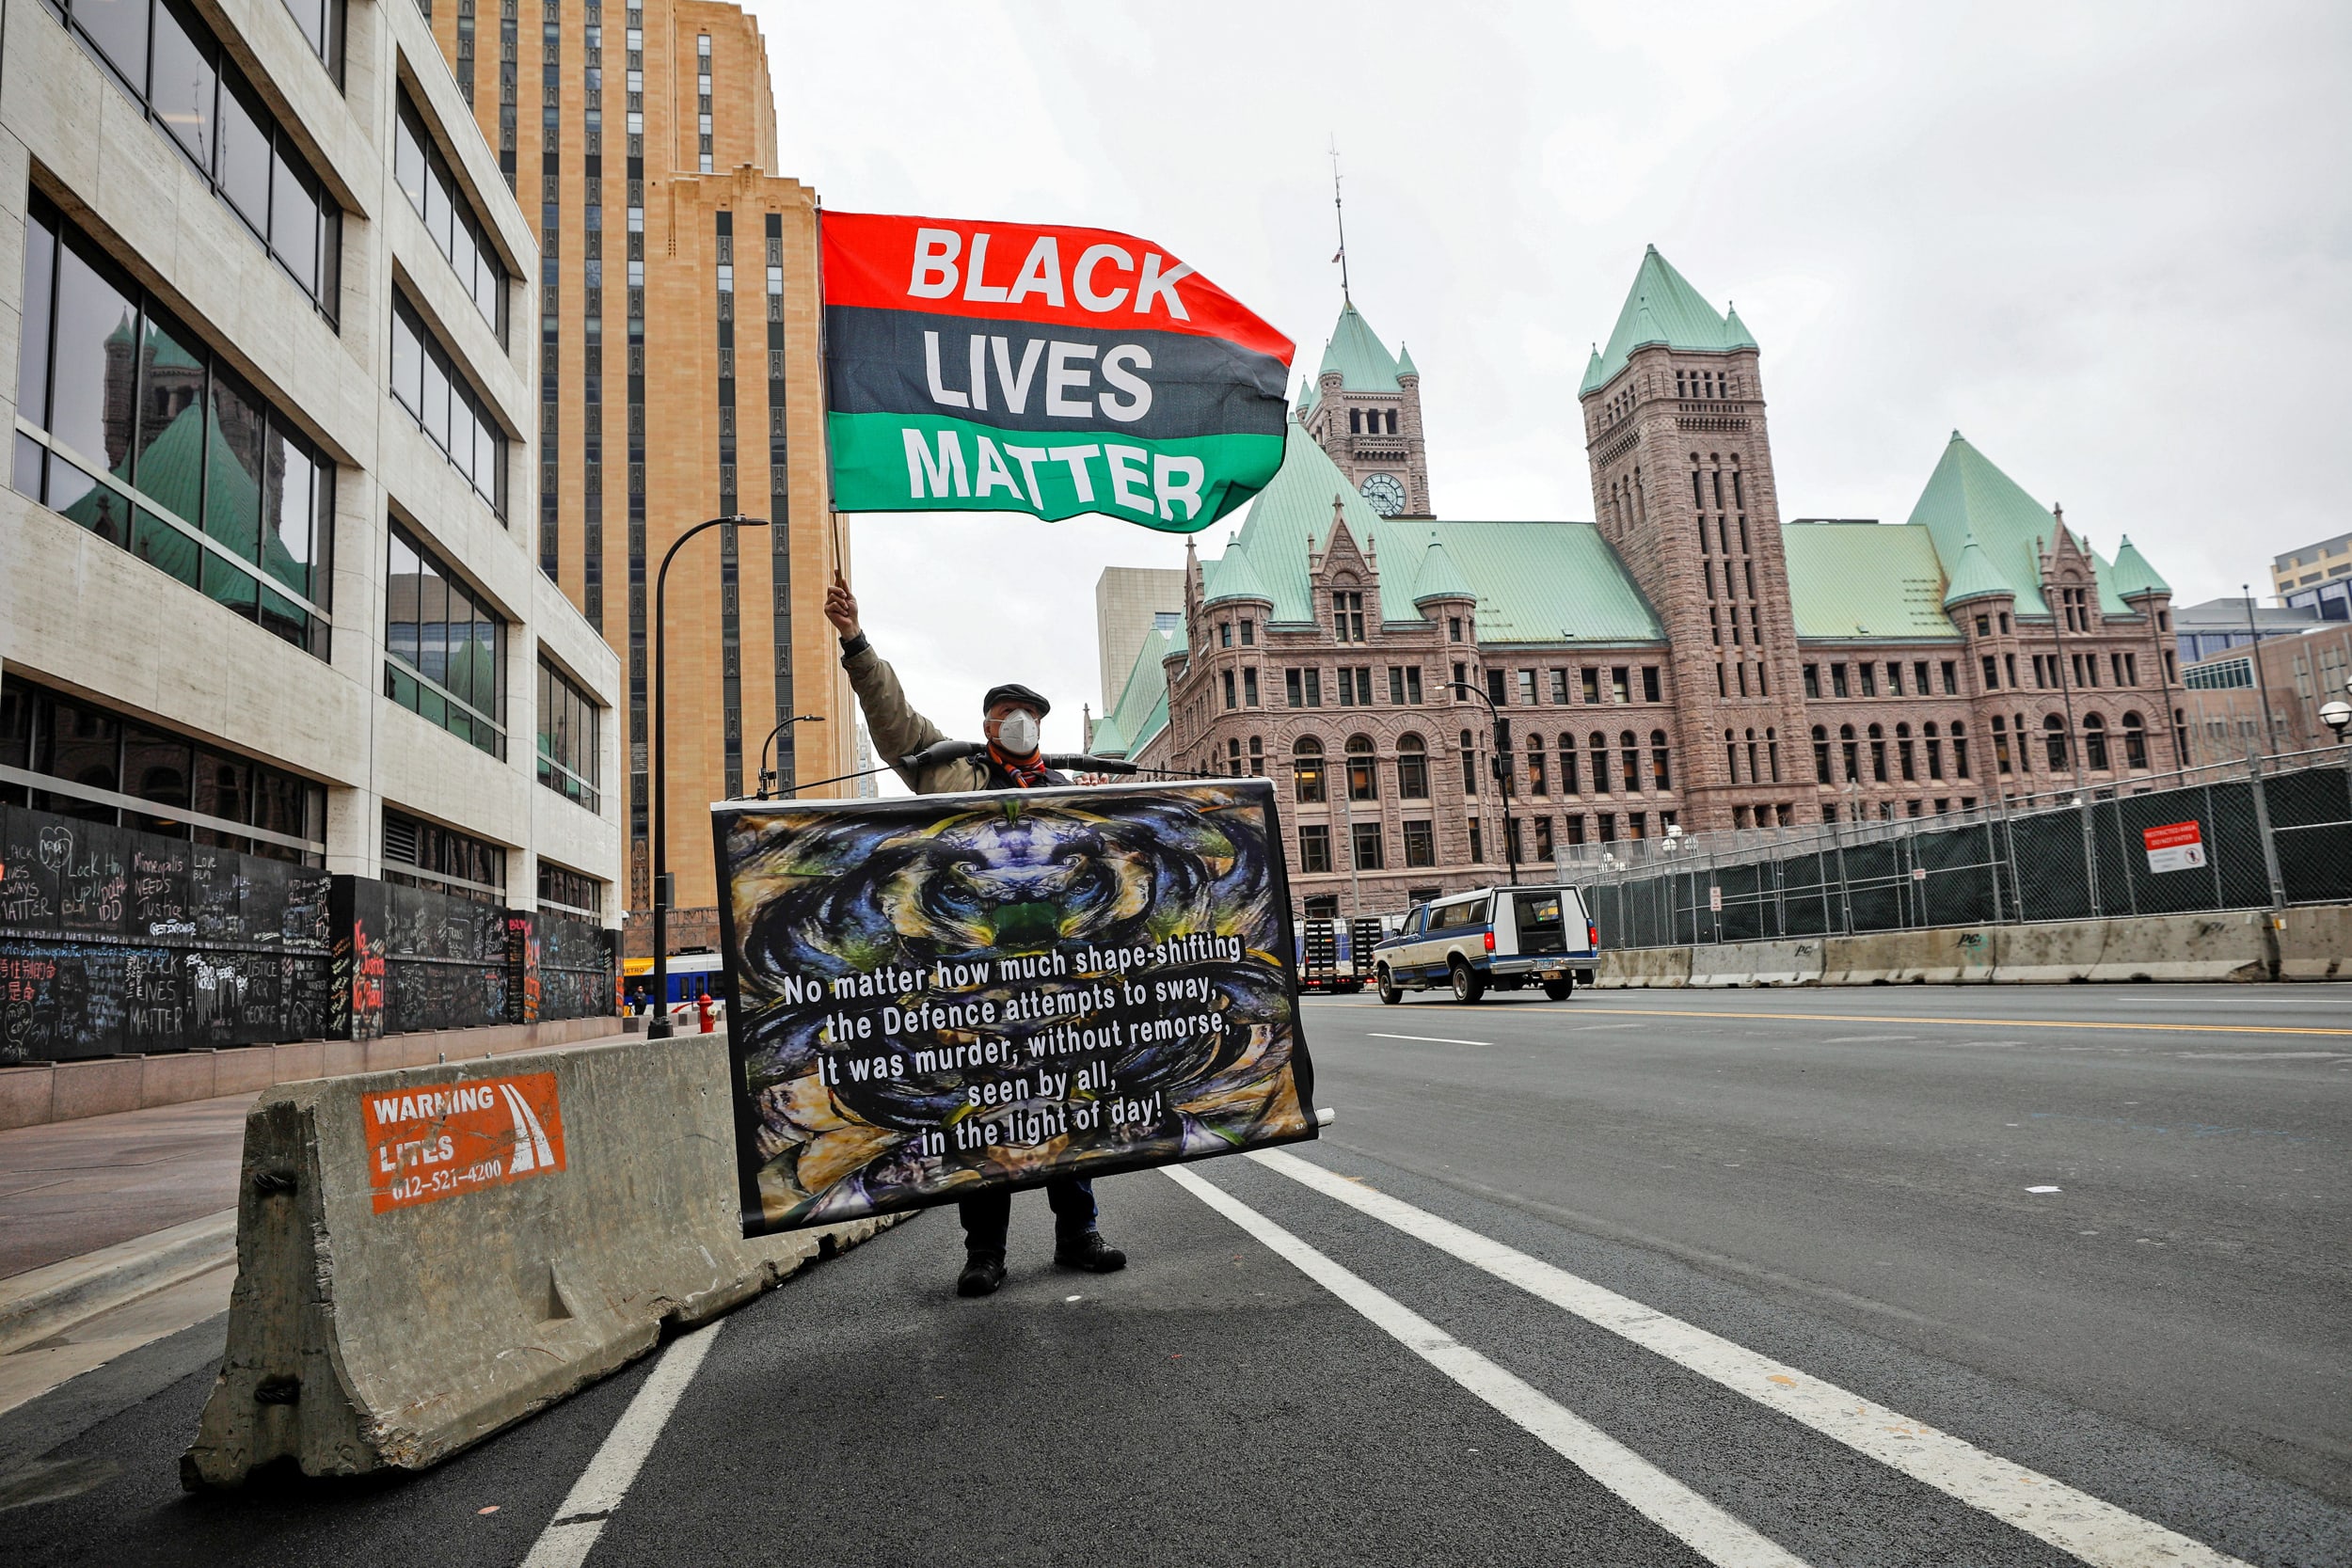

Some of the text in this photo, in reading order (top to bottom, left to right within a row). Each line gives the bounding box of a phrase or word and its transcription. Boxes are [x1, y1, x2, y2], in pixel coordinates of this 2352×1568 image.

[907, 228, 1196, 322] BLACK
[924, 331, 1152, 422] LIVES
[901, 429, 1205, 521] MATTER
[784, 933, 1241, 1006] No matter how much shape-shifting
[826, 975, 1216, 1042] the Defence attempts to sway,
[818, 1012, 1231, 1087] It was murder, without remorse,
[967, 1059, 1117, 1108] seen by all,
[373, 1085, 494, 1125] WARNING
[920, 1090, 1163, 1156] in the light of day!
